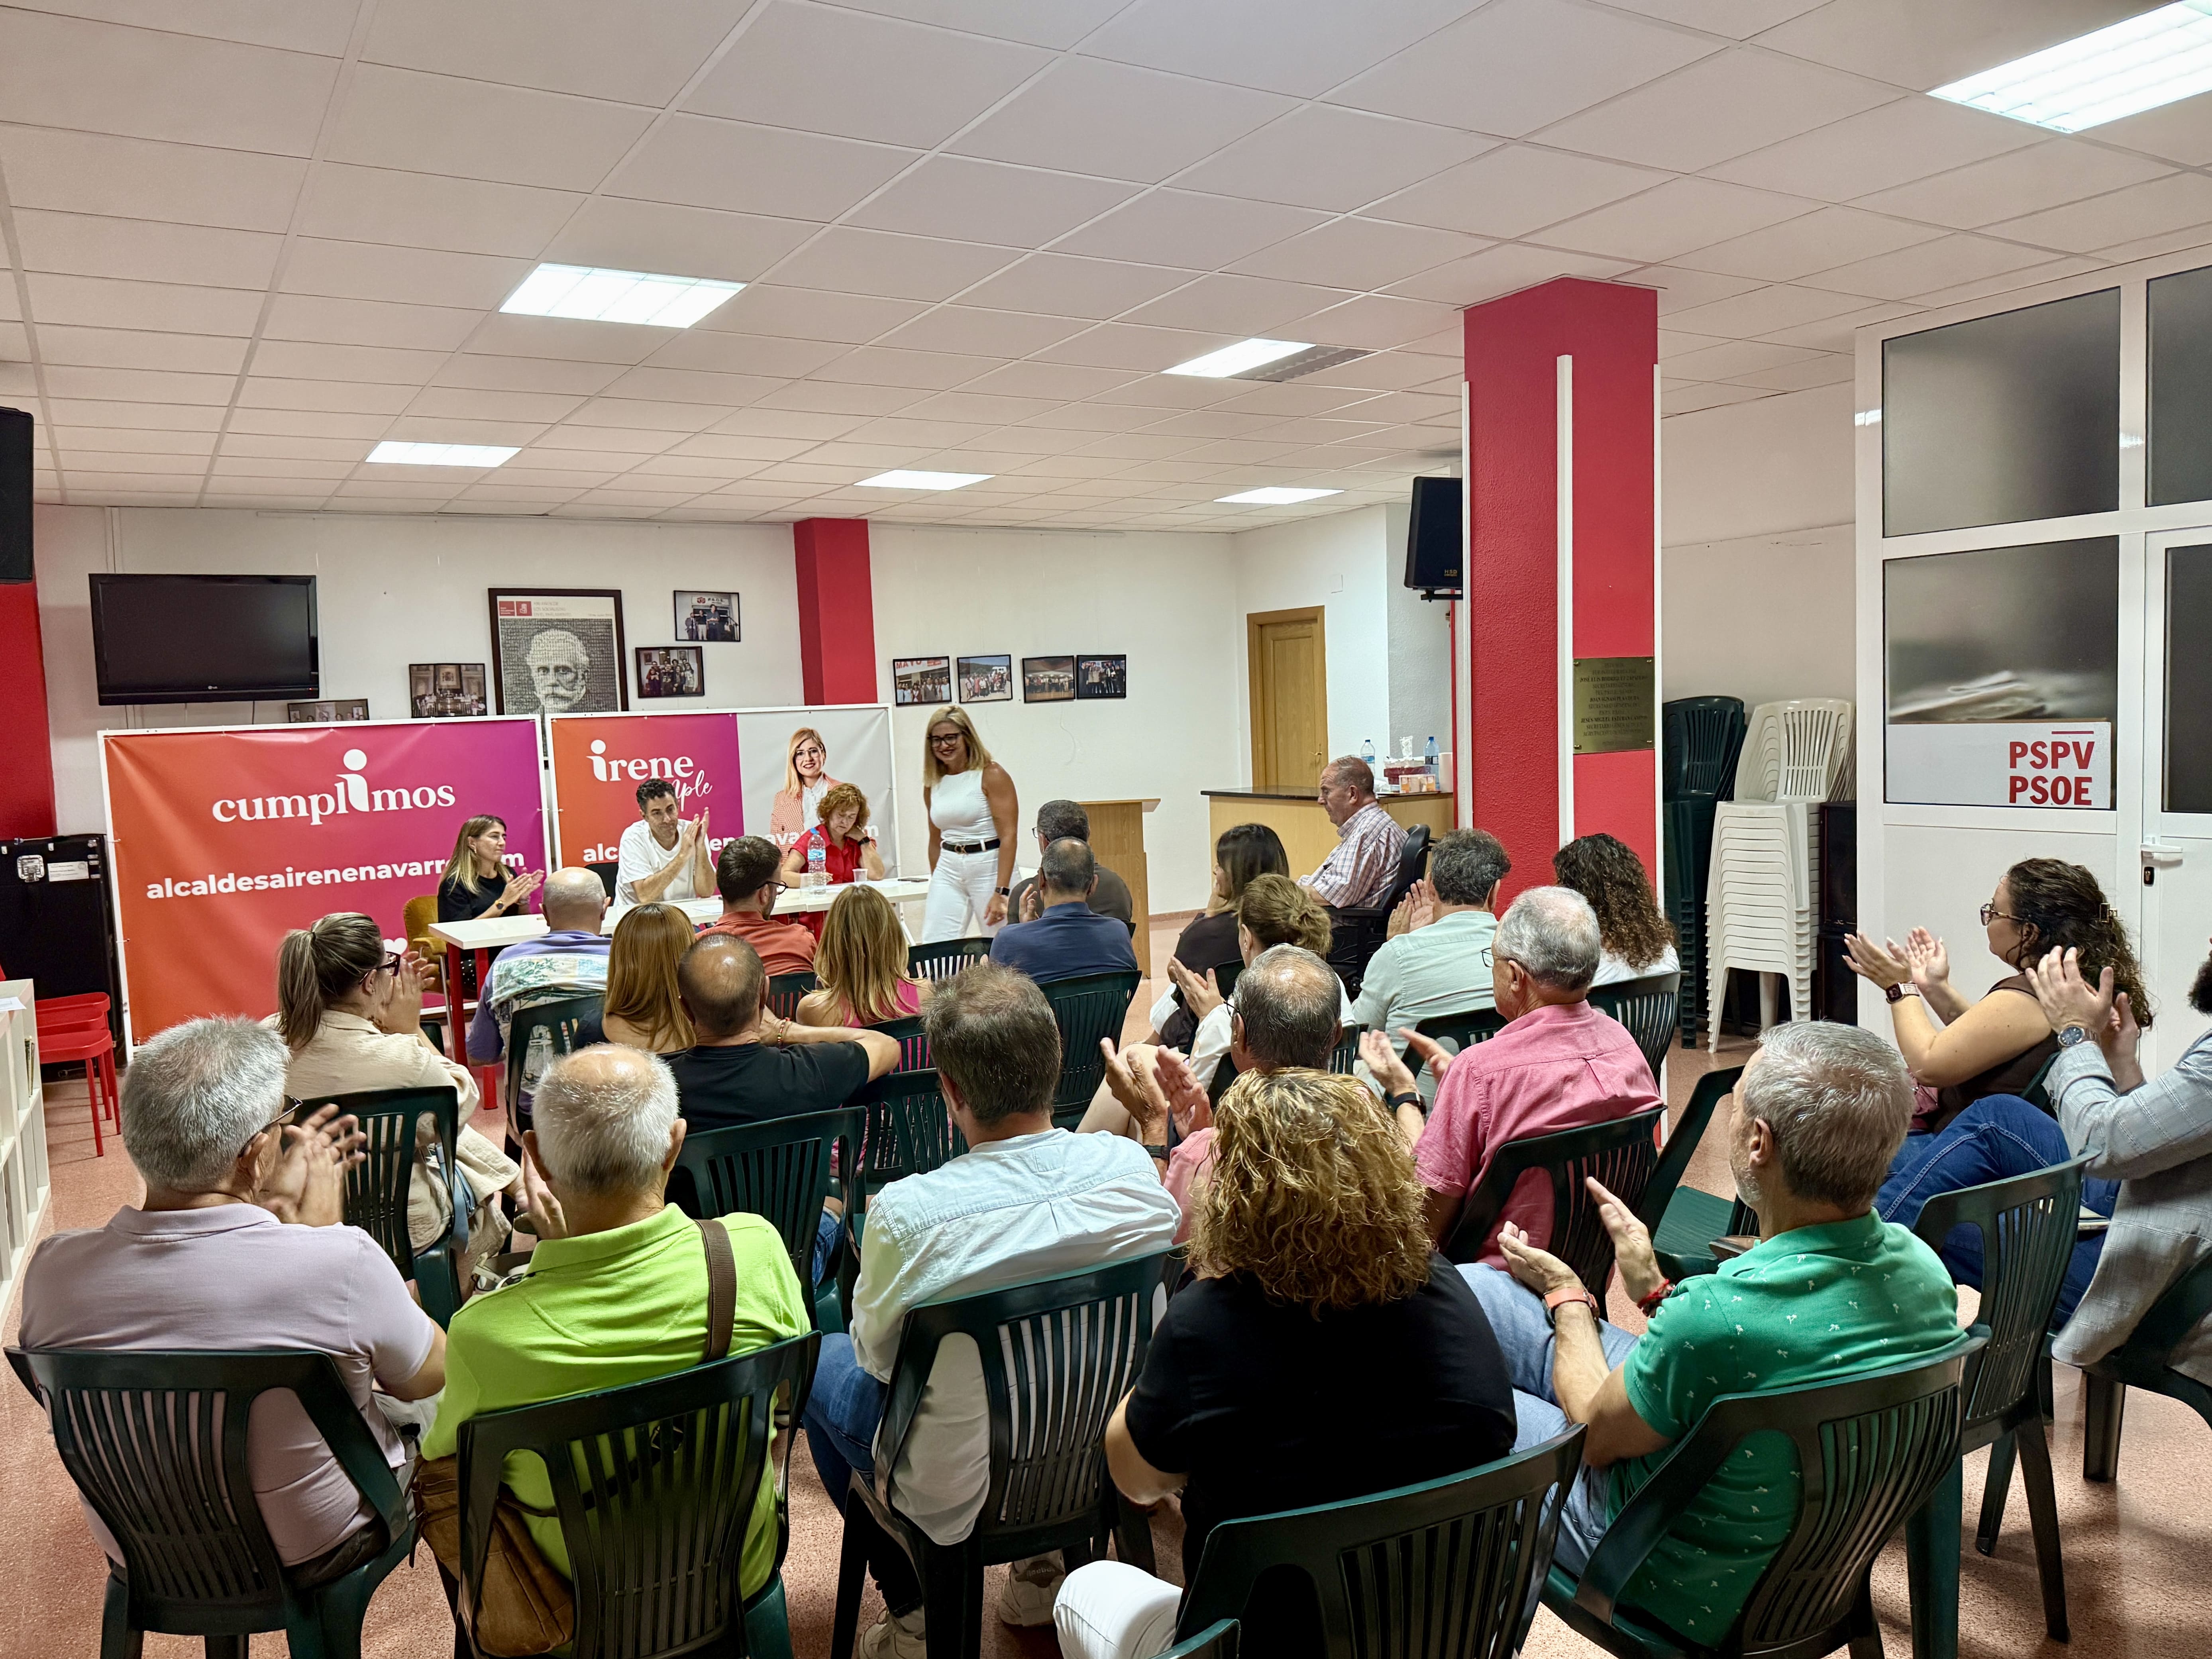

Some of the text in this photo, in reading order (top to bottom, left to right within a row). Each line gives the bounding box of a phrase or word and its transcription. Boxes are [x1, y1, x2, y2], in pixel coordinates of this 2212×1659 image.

[586, 739, 694, 781] irene
[2009, 741, 2094, 769] PSPV
[212, 749, 455, 825] cumplimos
[2009, 776, 2092, 805] PSOE
